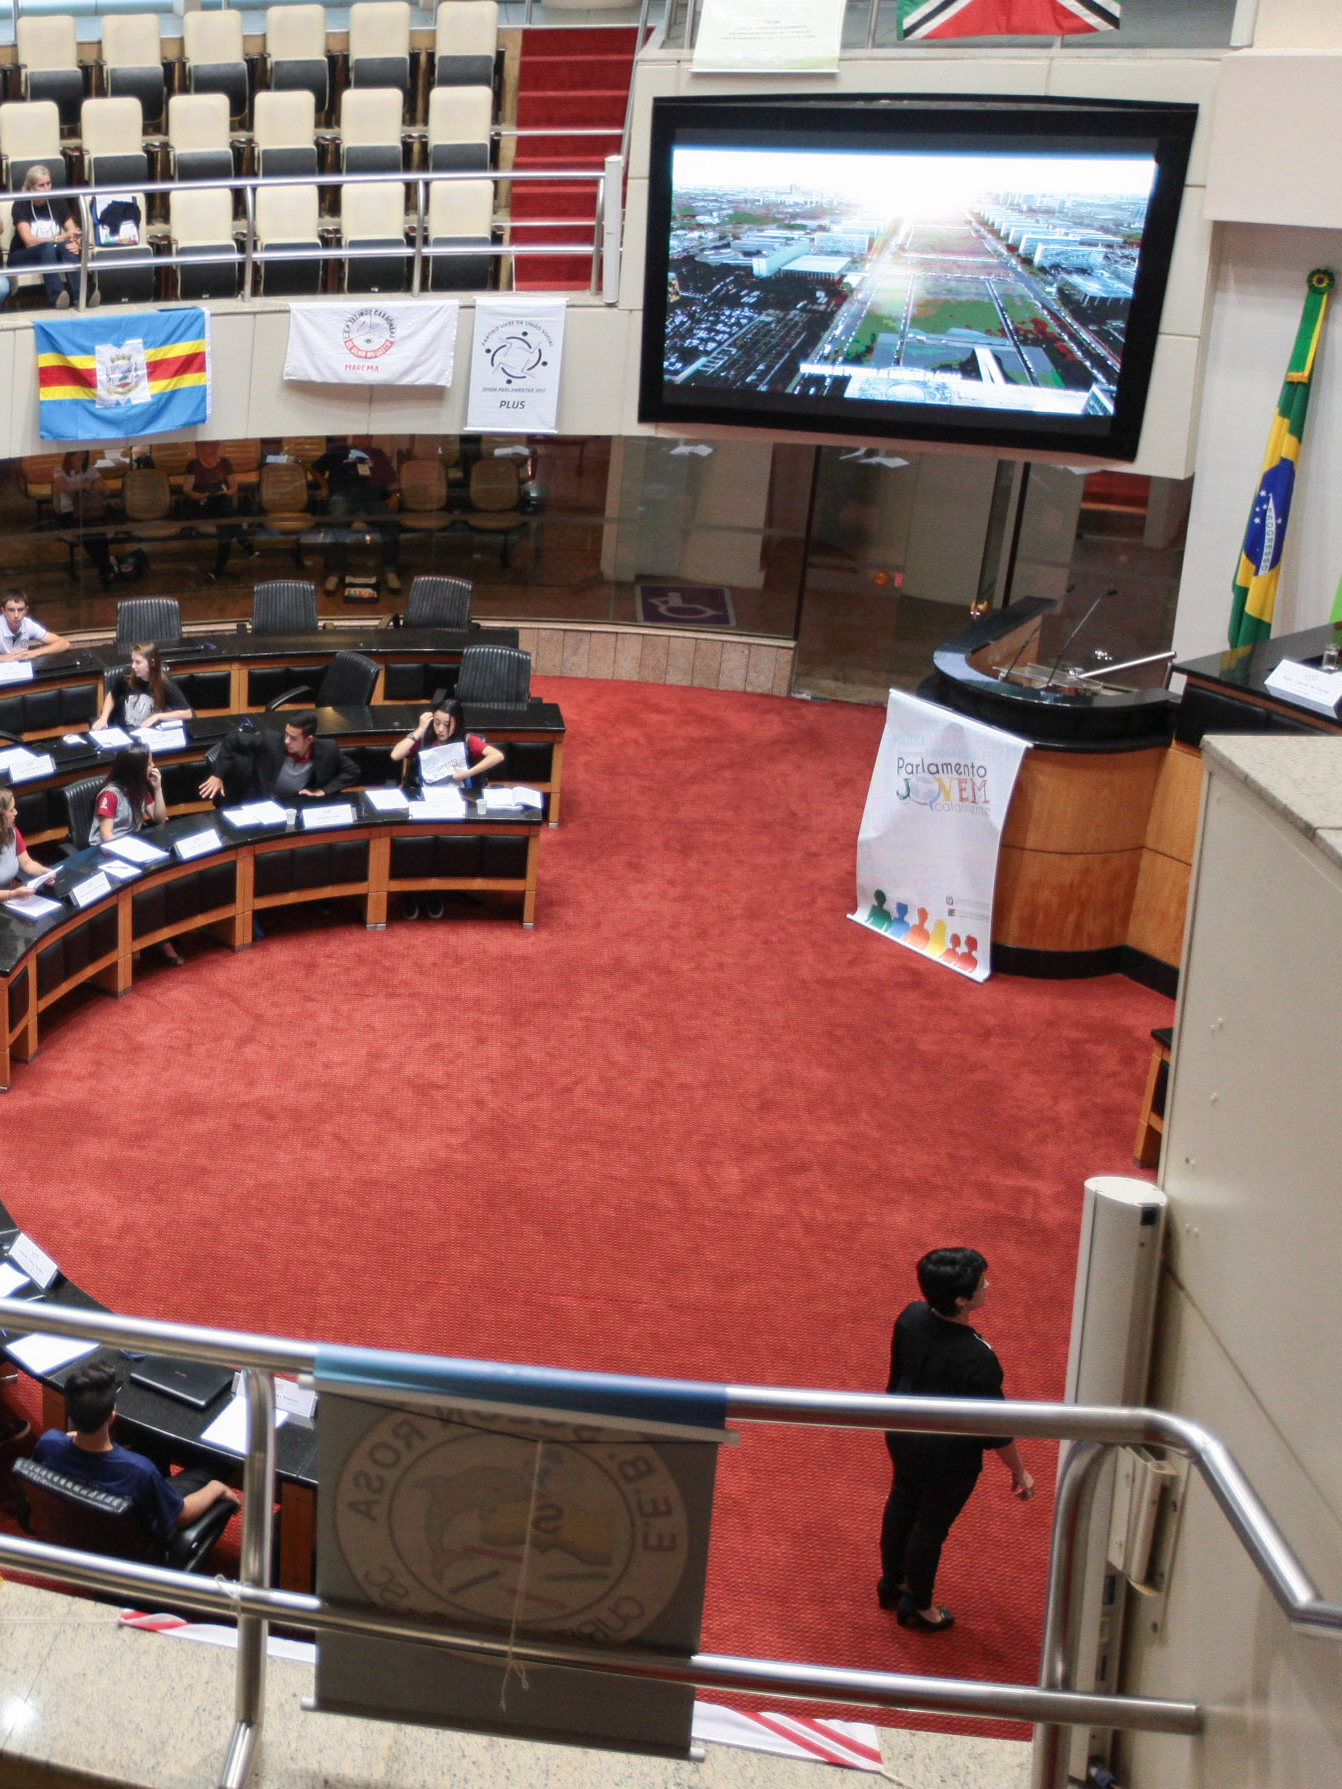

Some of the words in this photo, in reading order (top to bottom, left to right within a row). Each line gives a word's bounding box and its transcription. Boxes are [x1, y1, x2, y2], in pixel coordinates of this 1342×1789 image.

[344, 364, 379, 373] MAREMA
[499, 400, 526, 409] PLUS
[1261, 508, 1274, 571] PROGRESSO
[897, 757, 988, 778] Parlamento
[896, 775, 991, 808] JOVEM
